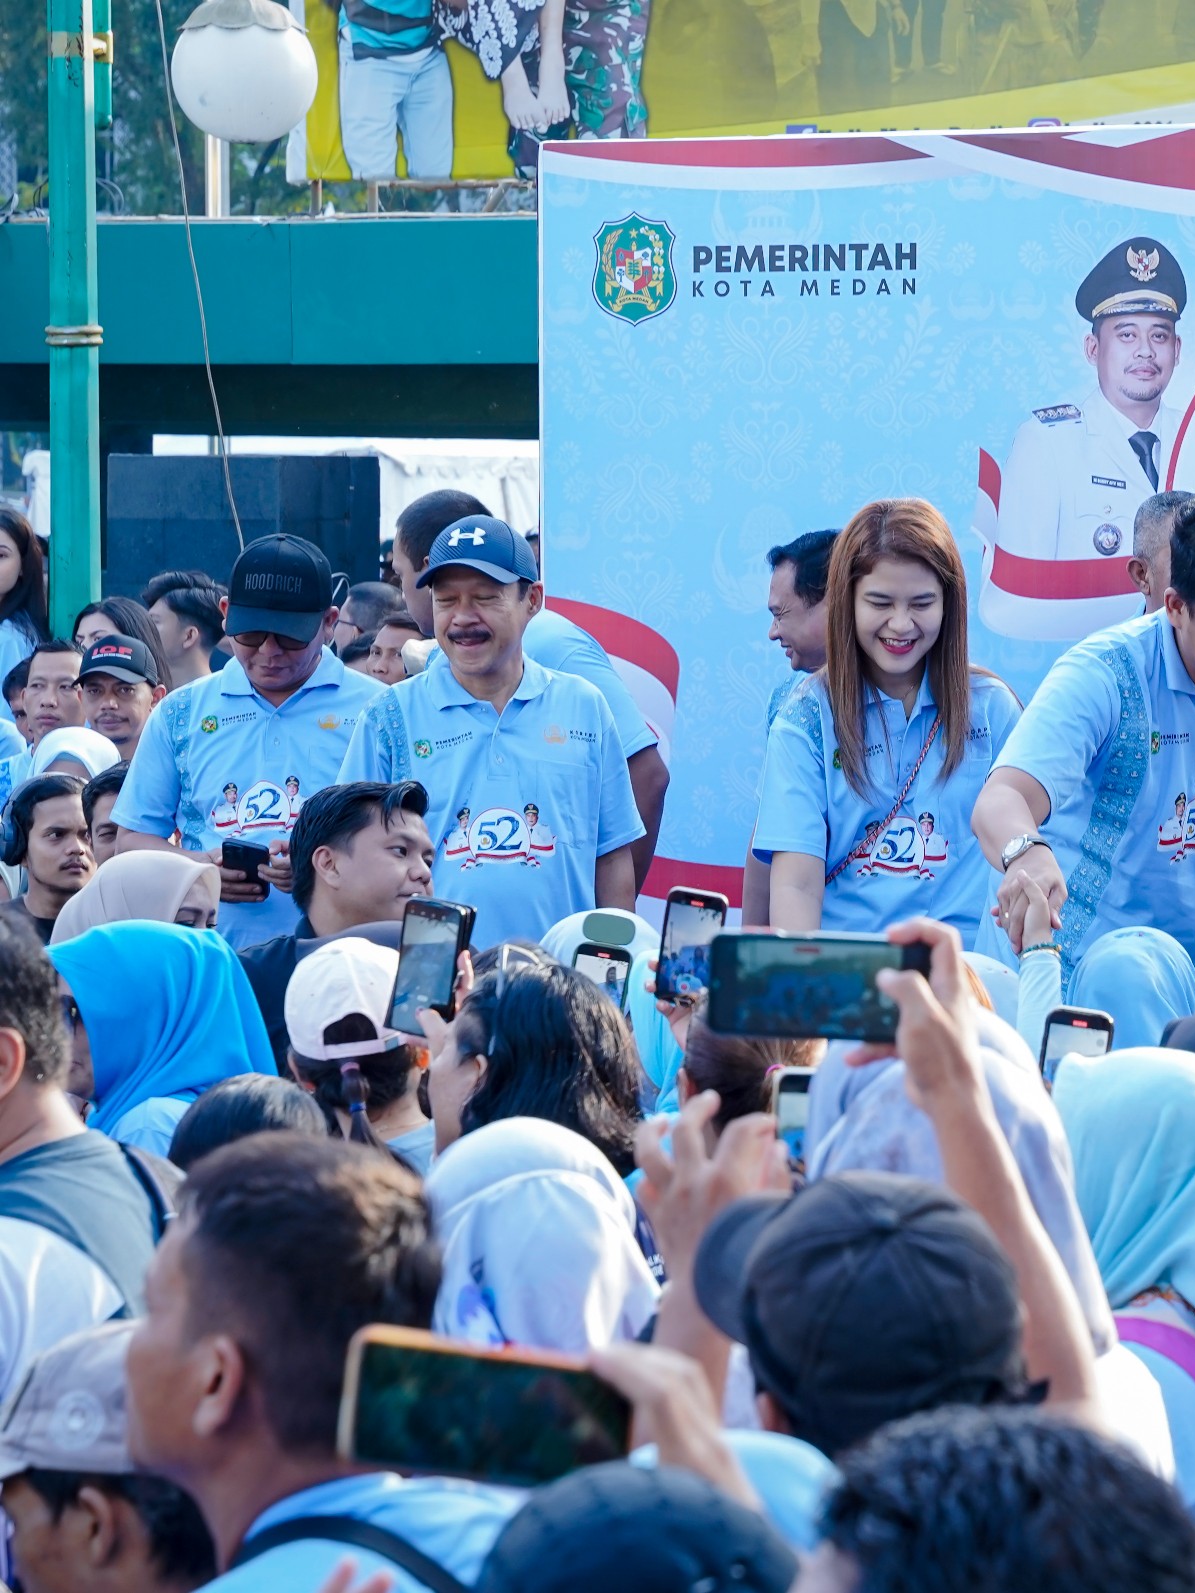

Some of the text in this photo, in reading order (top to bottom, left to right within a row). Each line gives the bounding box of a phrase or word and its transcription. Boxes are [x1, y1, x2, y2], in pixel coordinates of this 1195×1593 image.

[692, 242, 918, 273] PEMERINTAH
[692, 278, 917, 298] KOTA MEDAN
[244, 573, 302, 594] HOODRICH
[243, 788, 282, 823] 52
[477, 816, 523, 851] 52
[876, 826, 916, 863] 52
